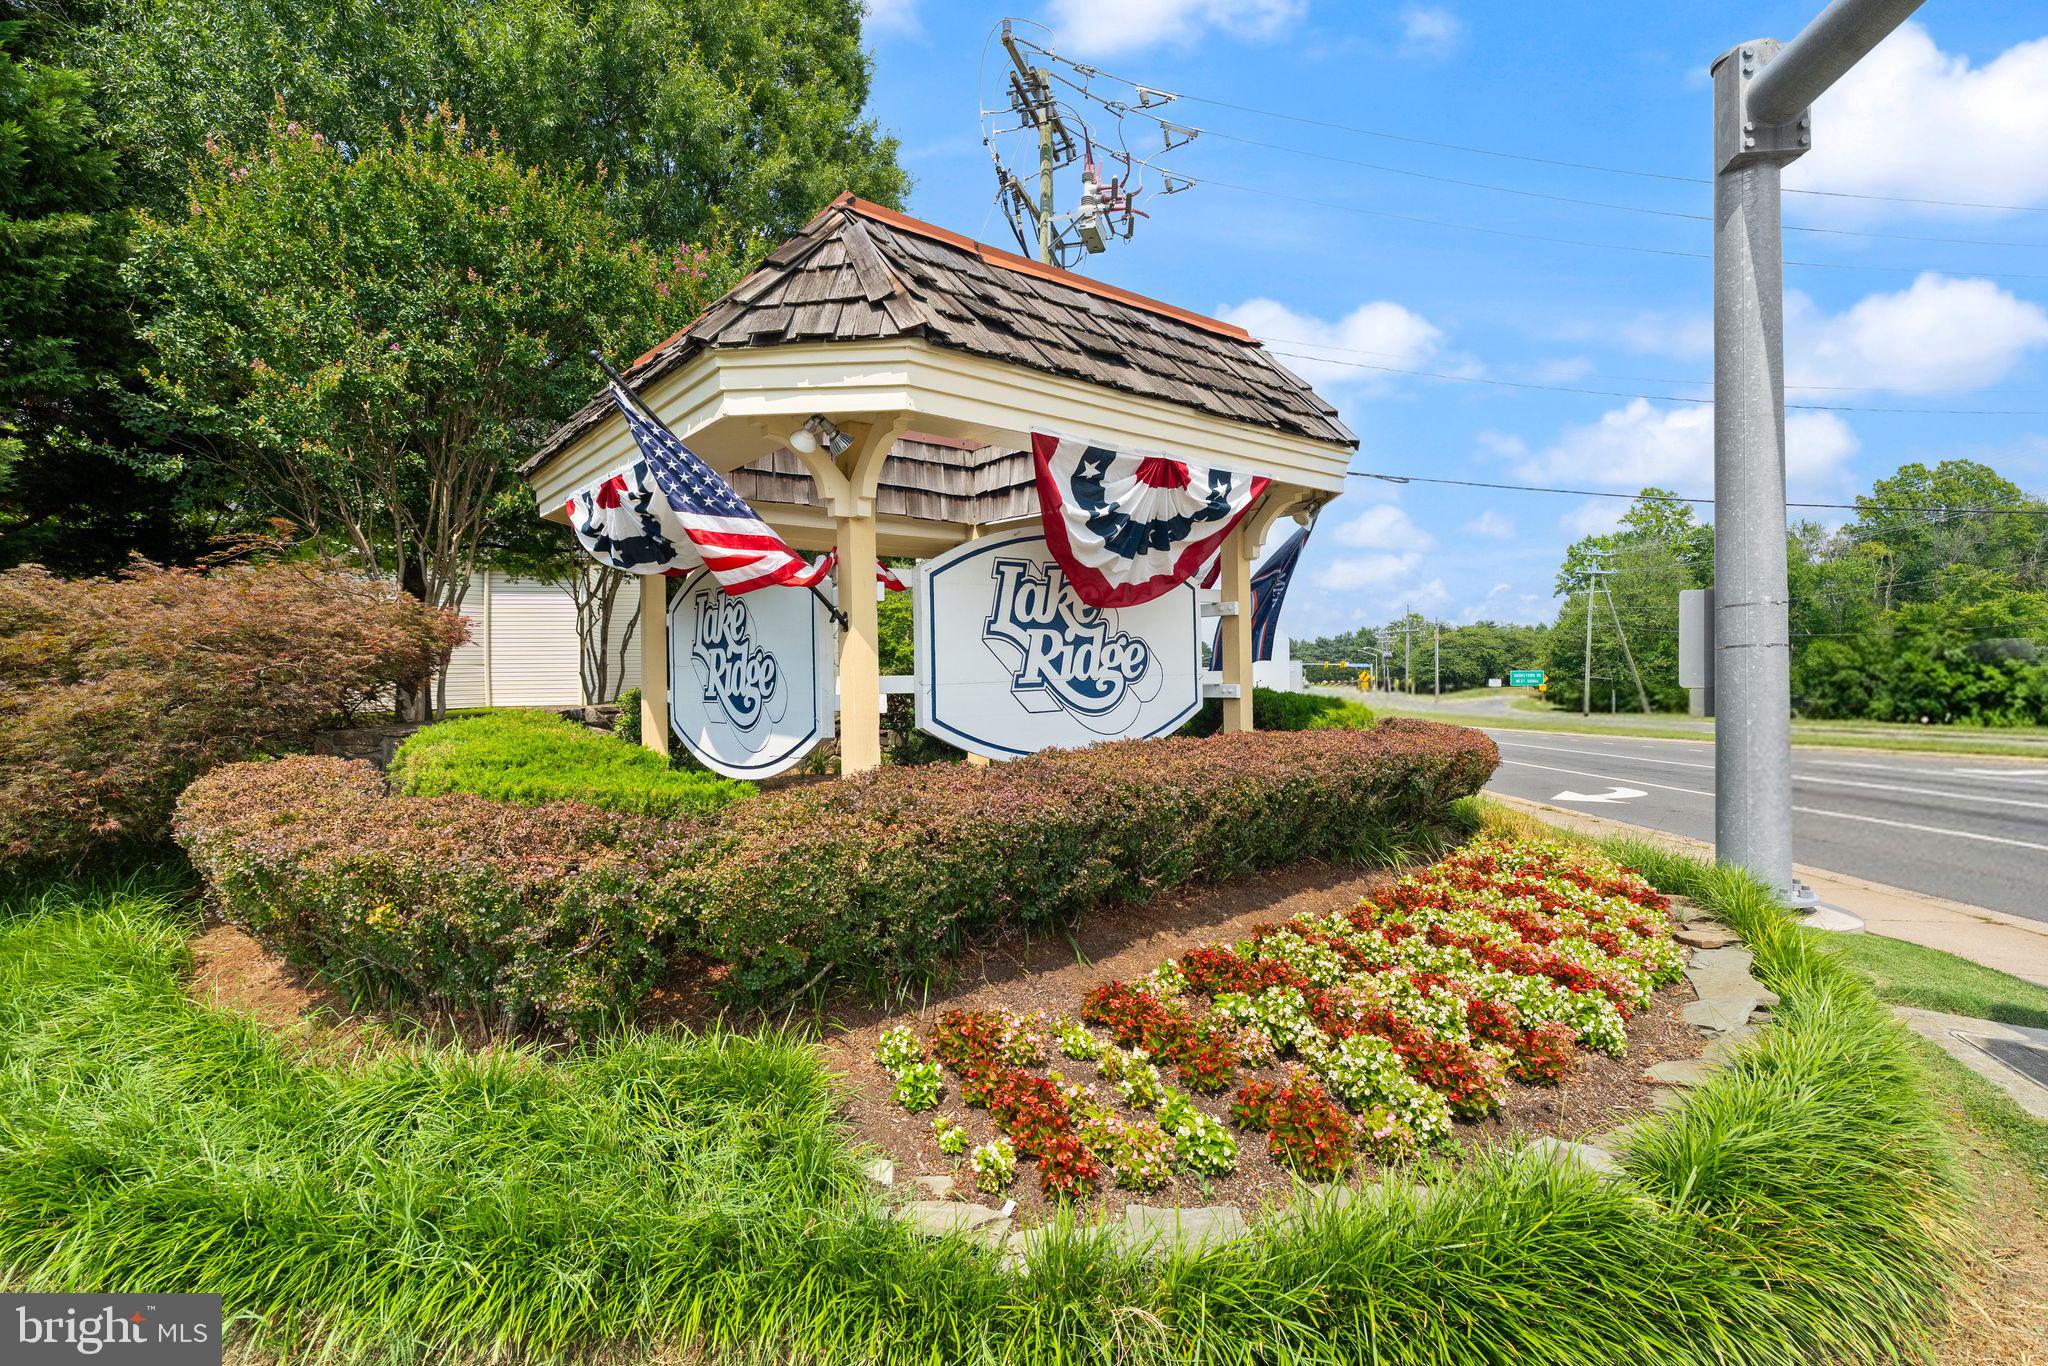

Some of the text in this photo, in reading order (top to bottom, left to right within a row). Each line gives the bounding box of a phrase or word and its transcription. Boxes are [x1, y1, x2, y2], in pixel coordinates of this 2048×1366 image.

[692, 591, 747, 660] Lake
[704, 647, 776, 727] Ridge
[1017, 628, 1148, 710] Ridge
